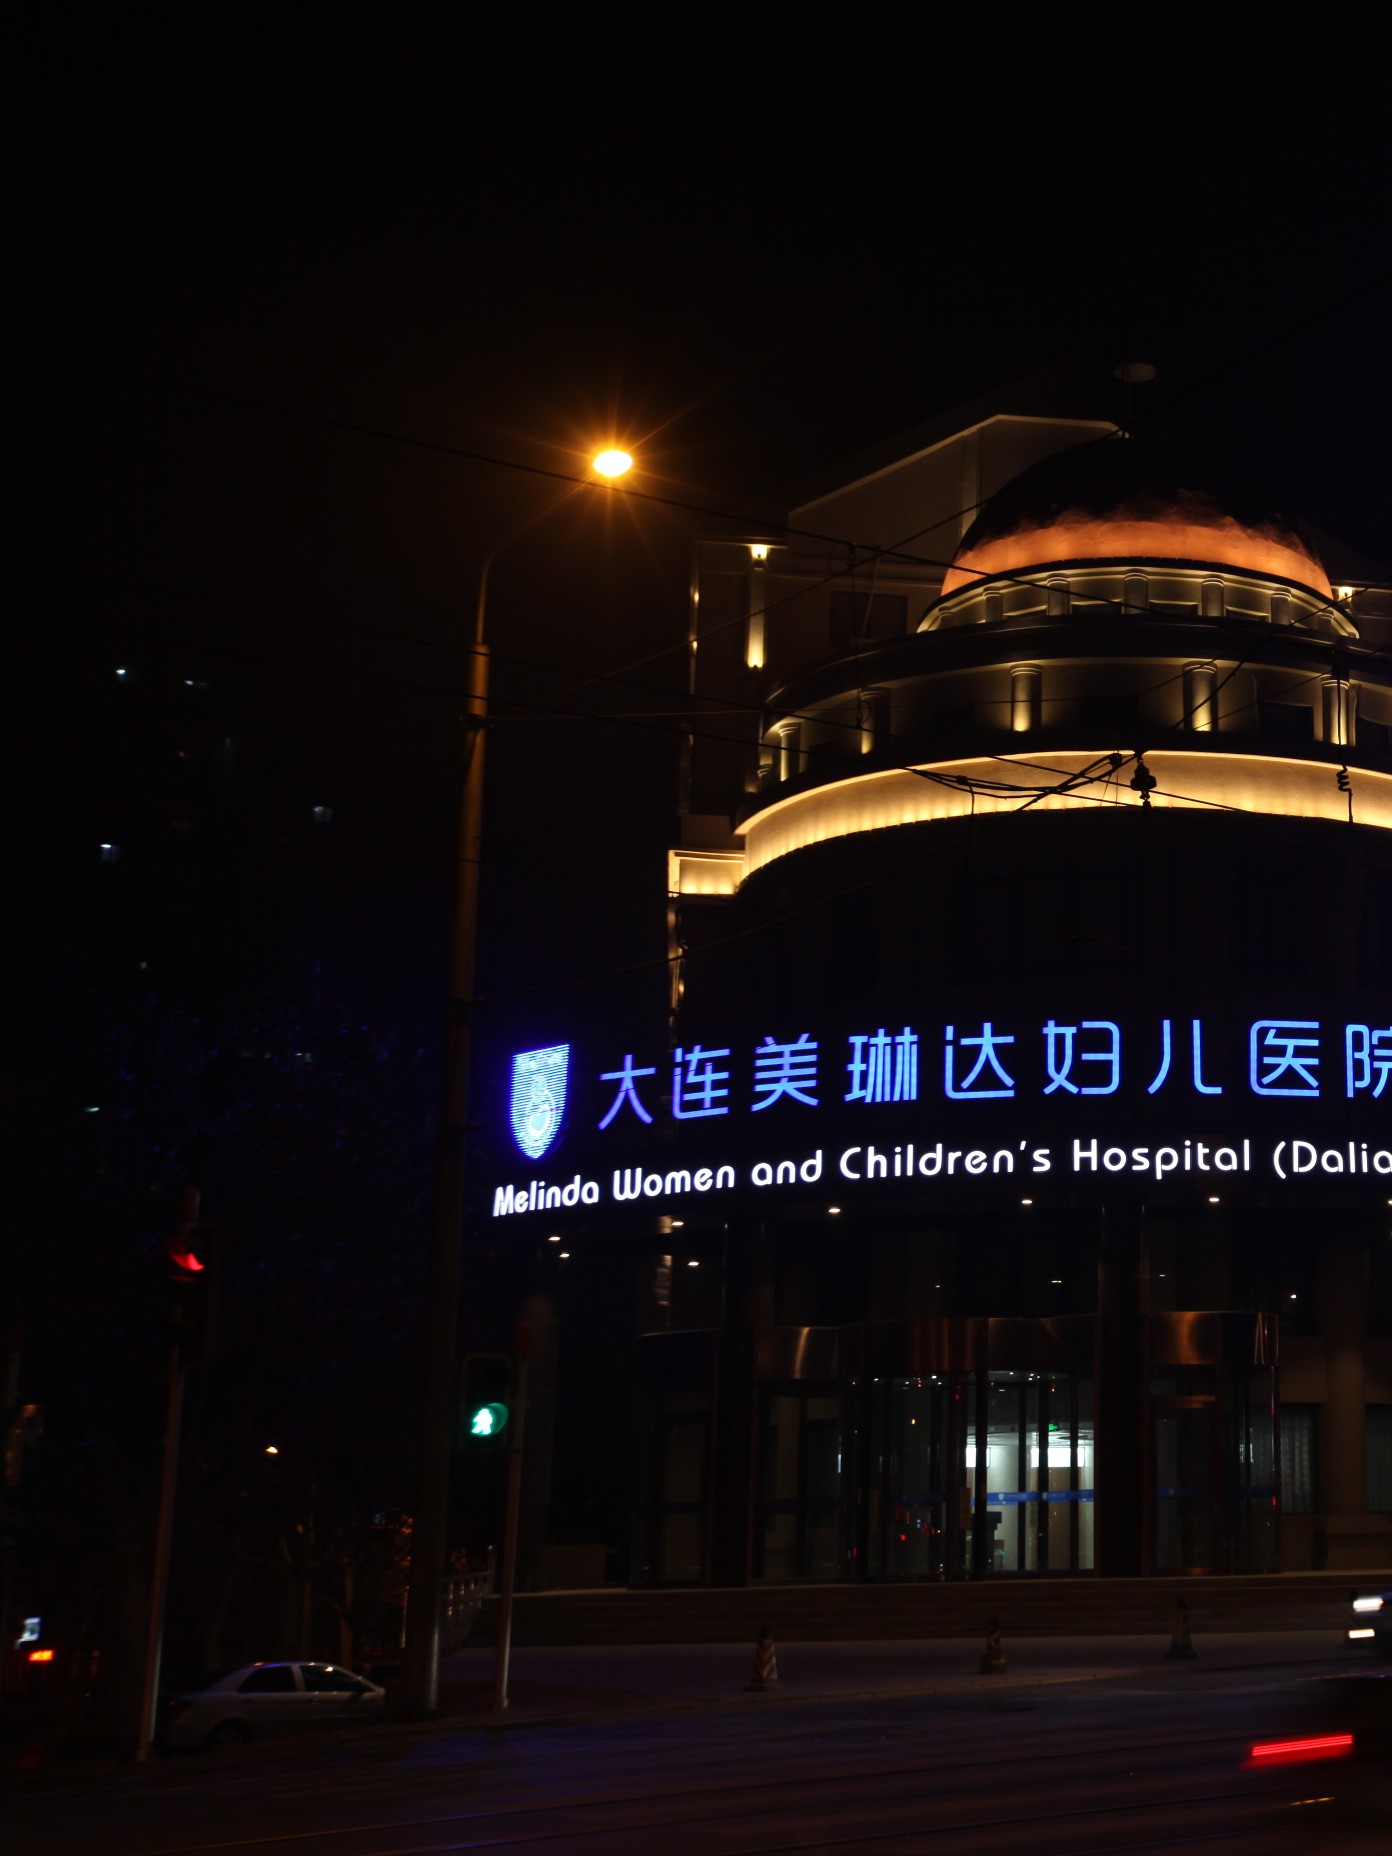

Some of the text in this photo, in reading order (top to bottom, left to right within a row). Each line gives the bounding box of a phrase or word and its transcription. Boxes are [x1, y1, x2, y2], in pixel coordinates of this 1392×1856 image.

[494, 1175, 598, 1216] Melinda
[614, 1166, 734, 1200] Women
[752, 1150, 821, 1185] and
[840, 1141, 1050, 1178] Children's
[1074, 1139, 1249, 1179] Hospital
